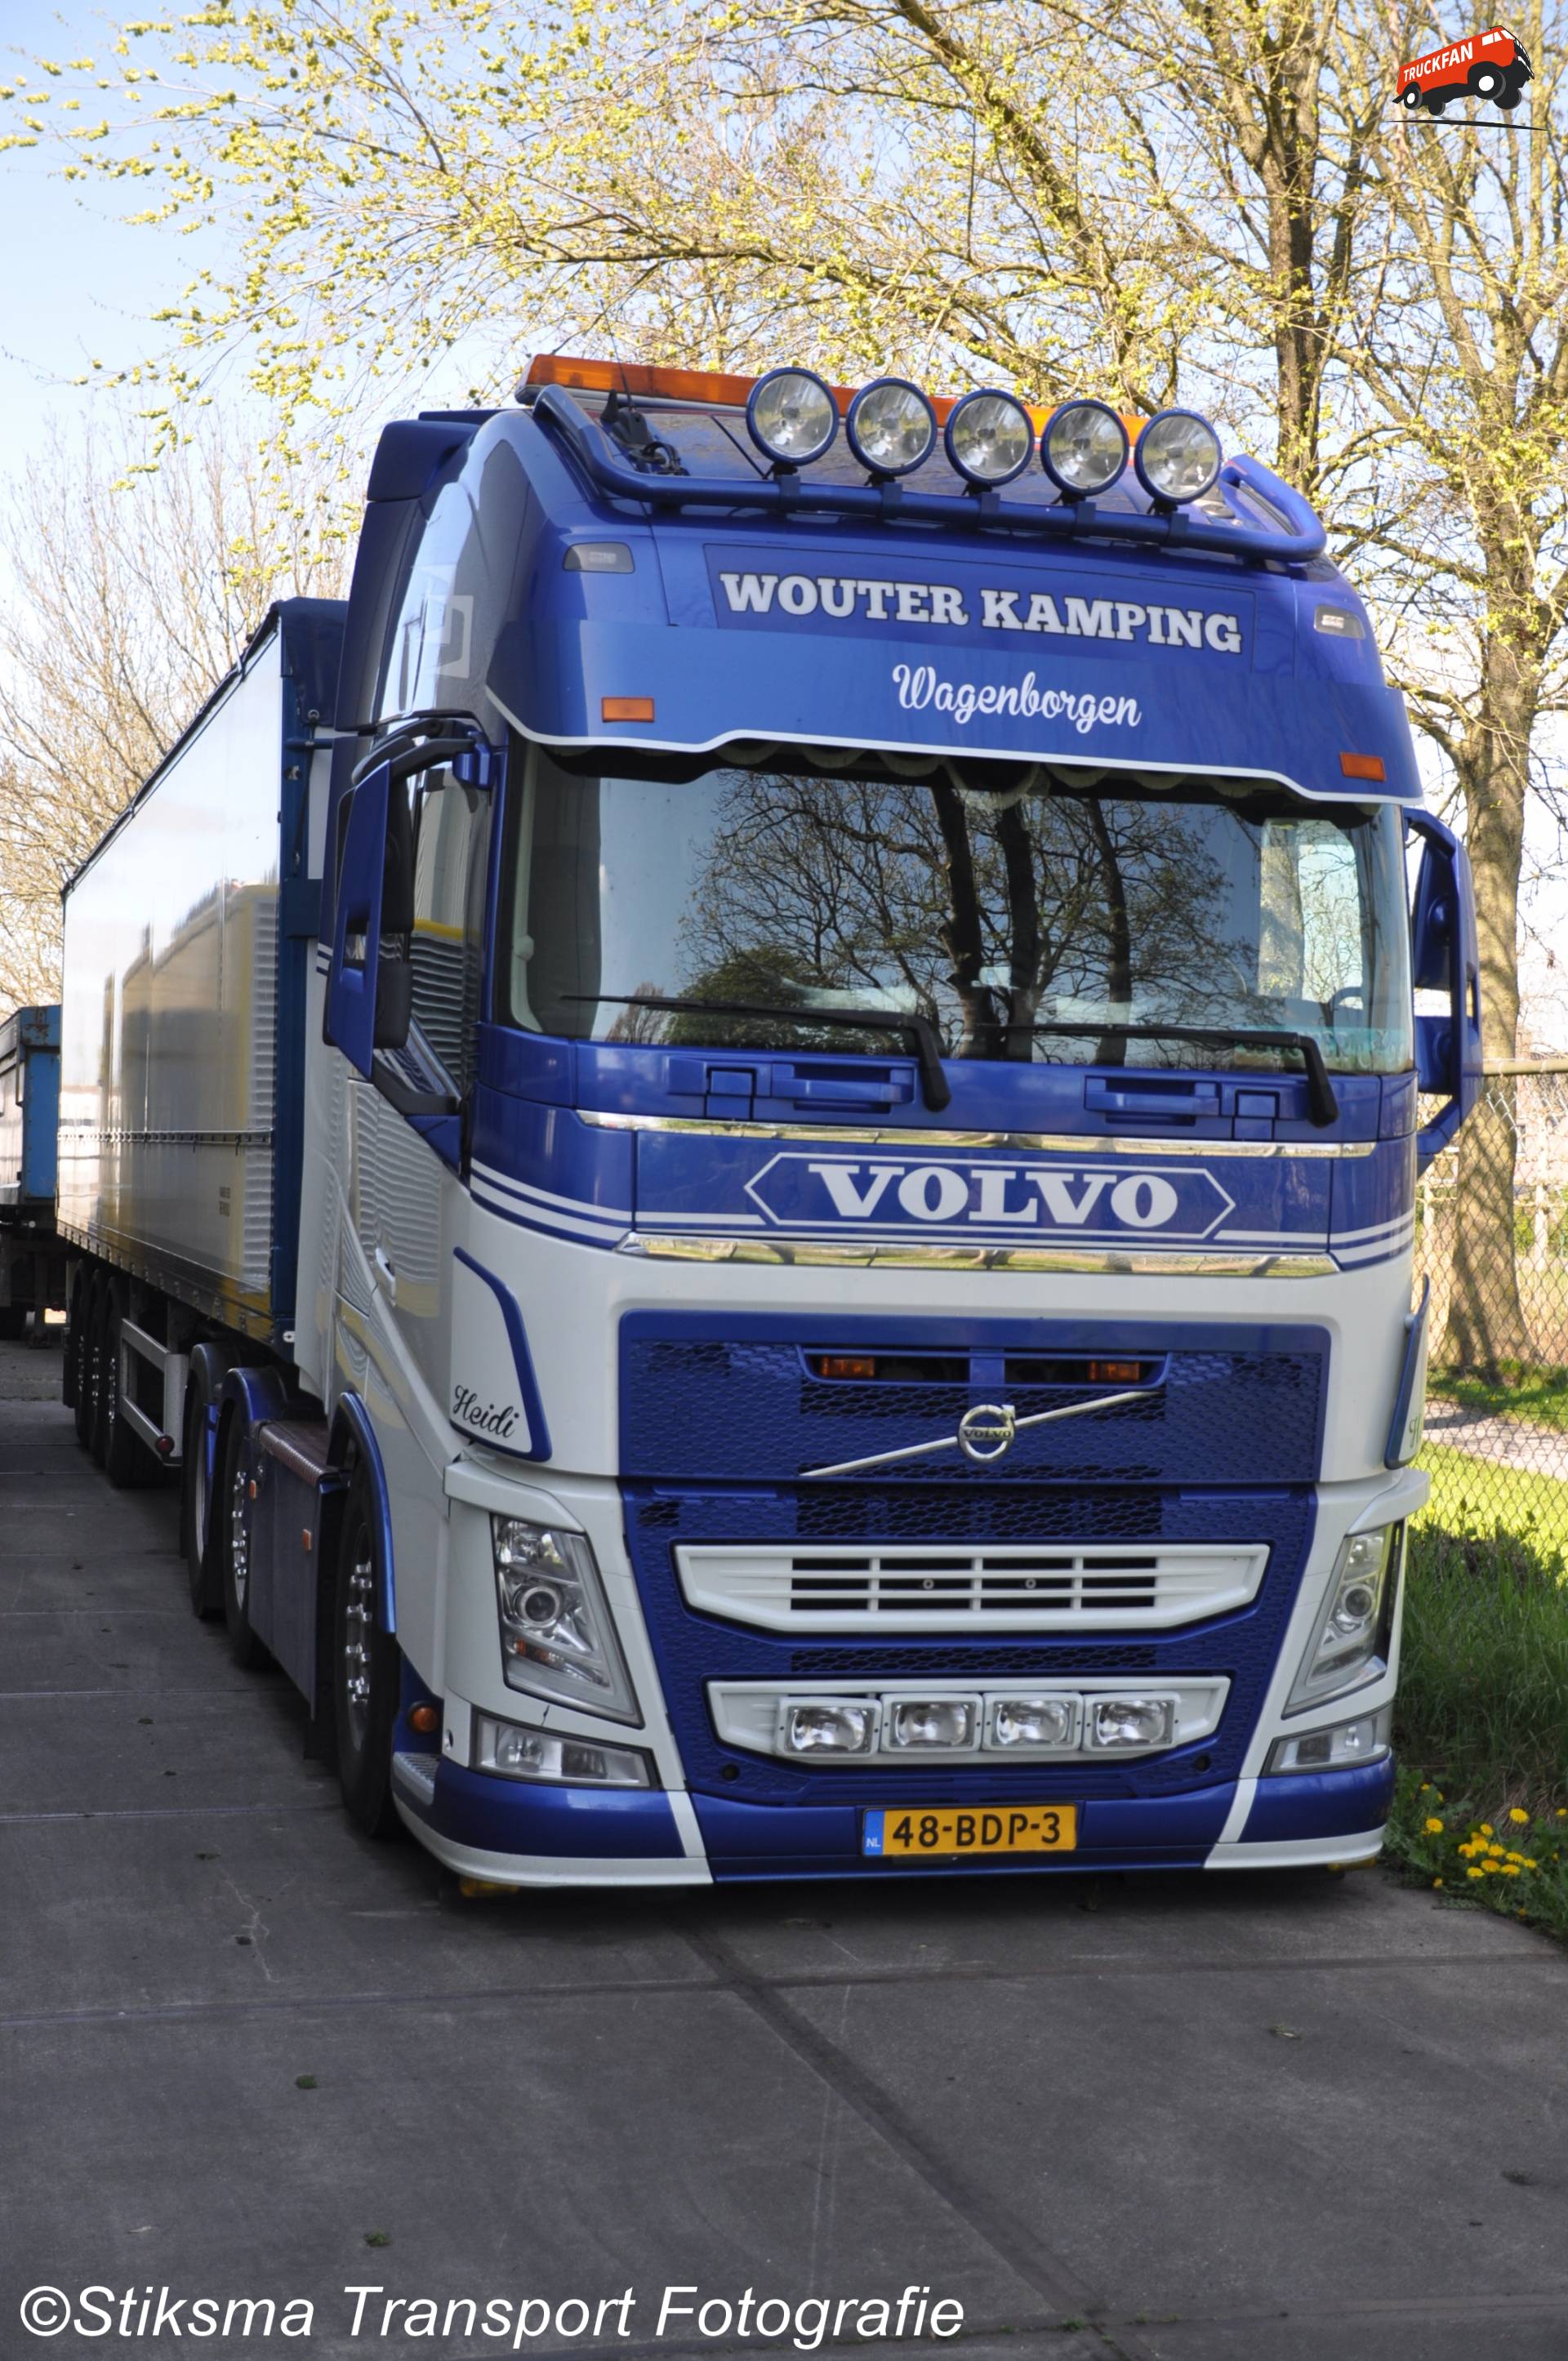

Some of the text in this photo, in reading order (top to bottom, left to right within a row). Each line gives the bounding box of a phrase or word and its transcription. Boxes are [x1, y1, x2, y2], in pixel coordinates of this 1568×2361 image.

[719, 572, 1243, 653] WOUTER KAMPING
[892, 663, 1142, 733] Wagenborgen
[808, 1163, 1178, 1227] VOLVO
[452, 1384, 519, 1437] Heidi
[964, 1430, 1012, 1438] VOLVO
[866, 1837, 881, 1847] NL
[892, 1811, 1061, 1848] 48-BDP-3
